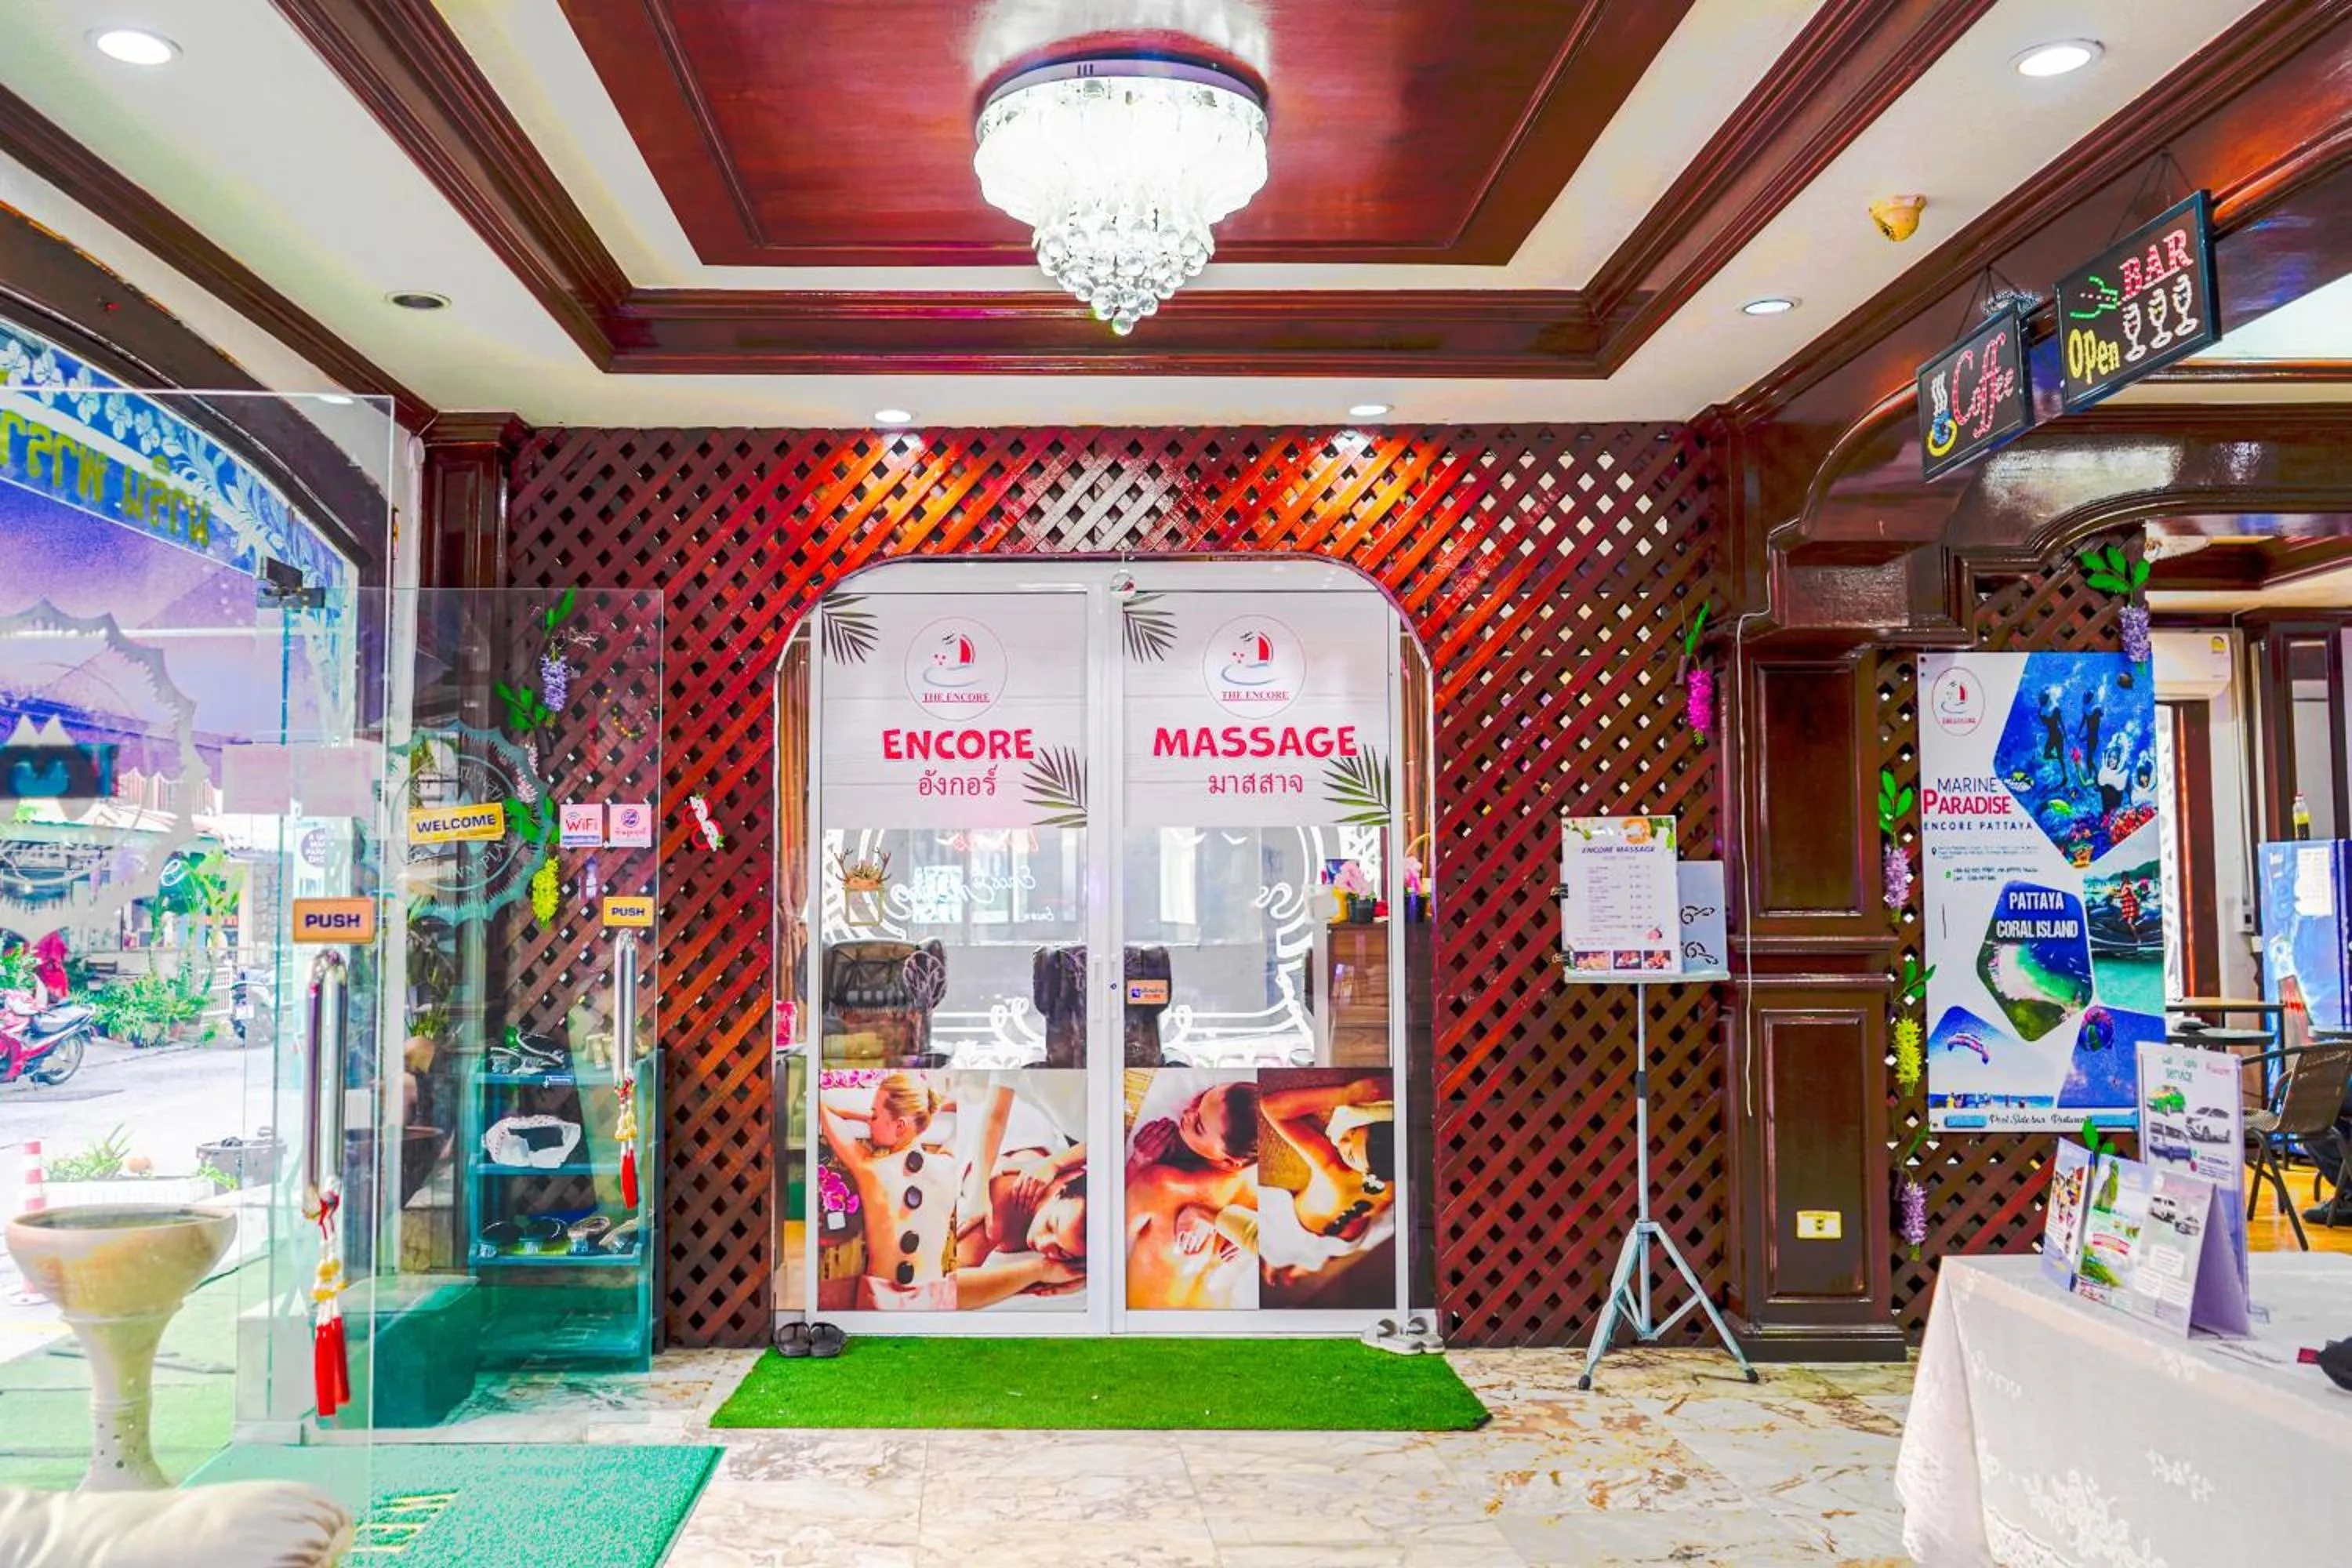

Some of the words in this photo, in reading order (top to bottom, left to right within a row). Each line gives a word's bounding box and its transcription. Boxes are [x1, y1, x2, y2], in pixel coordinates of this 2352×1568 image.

[2119, 229, 2194, 301] BAR
[1221, 691, 1241, 700] THE
[1244, 691, 1290, 700] ENCORE
[883, 728, 1034, 760] ENCORE
[1153, 726, 1358, 757] MASSAGE
[918, 764, 998, 797] อังกอร์
[1208, 773, 1303, 794] มาสสาจ
[1937, 778, 1998, 793] MARINE
[416, 814, 496, 833] WELCOME
[1924, 822, 1971, 830] ENCORE
[1980, 822, 2033, 830] PATTAYA
[2009, 891, 2064, 910] PATTAYA
[304, 913, 361, 929] PUSH
[612, 907, 645, 917] PUSH
[1996, 920, 2034, 938] CORAL
[2036, 920, 2078, 938] ISLAND
